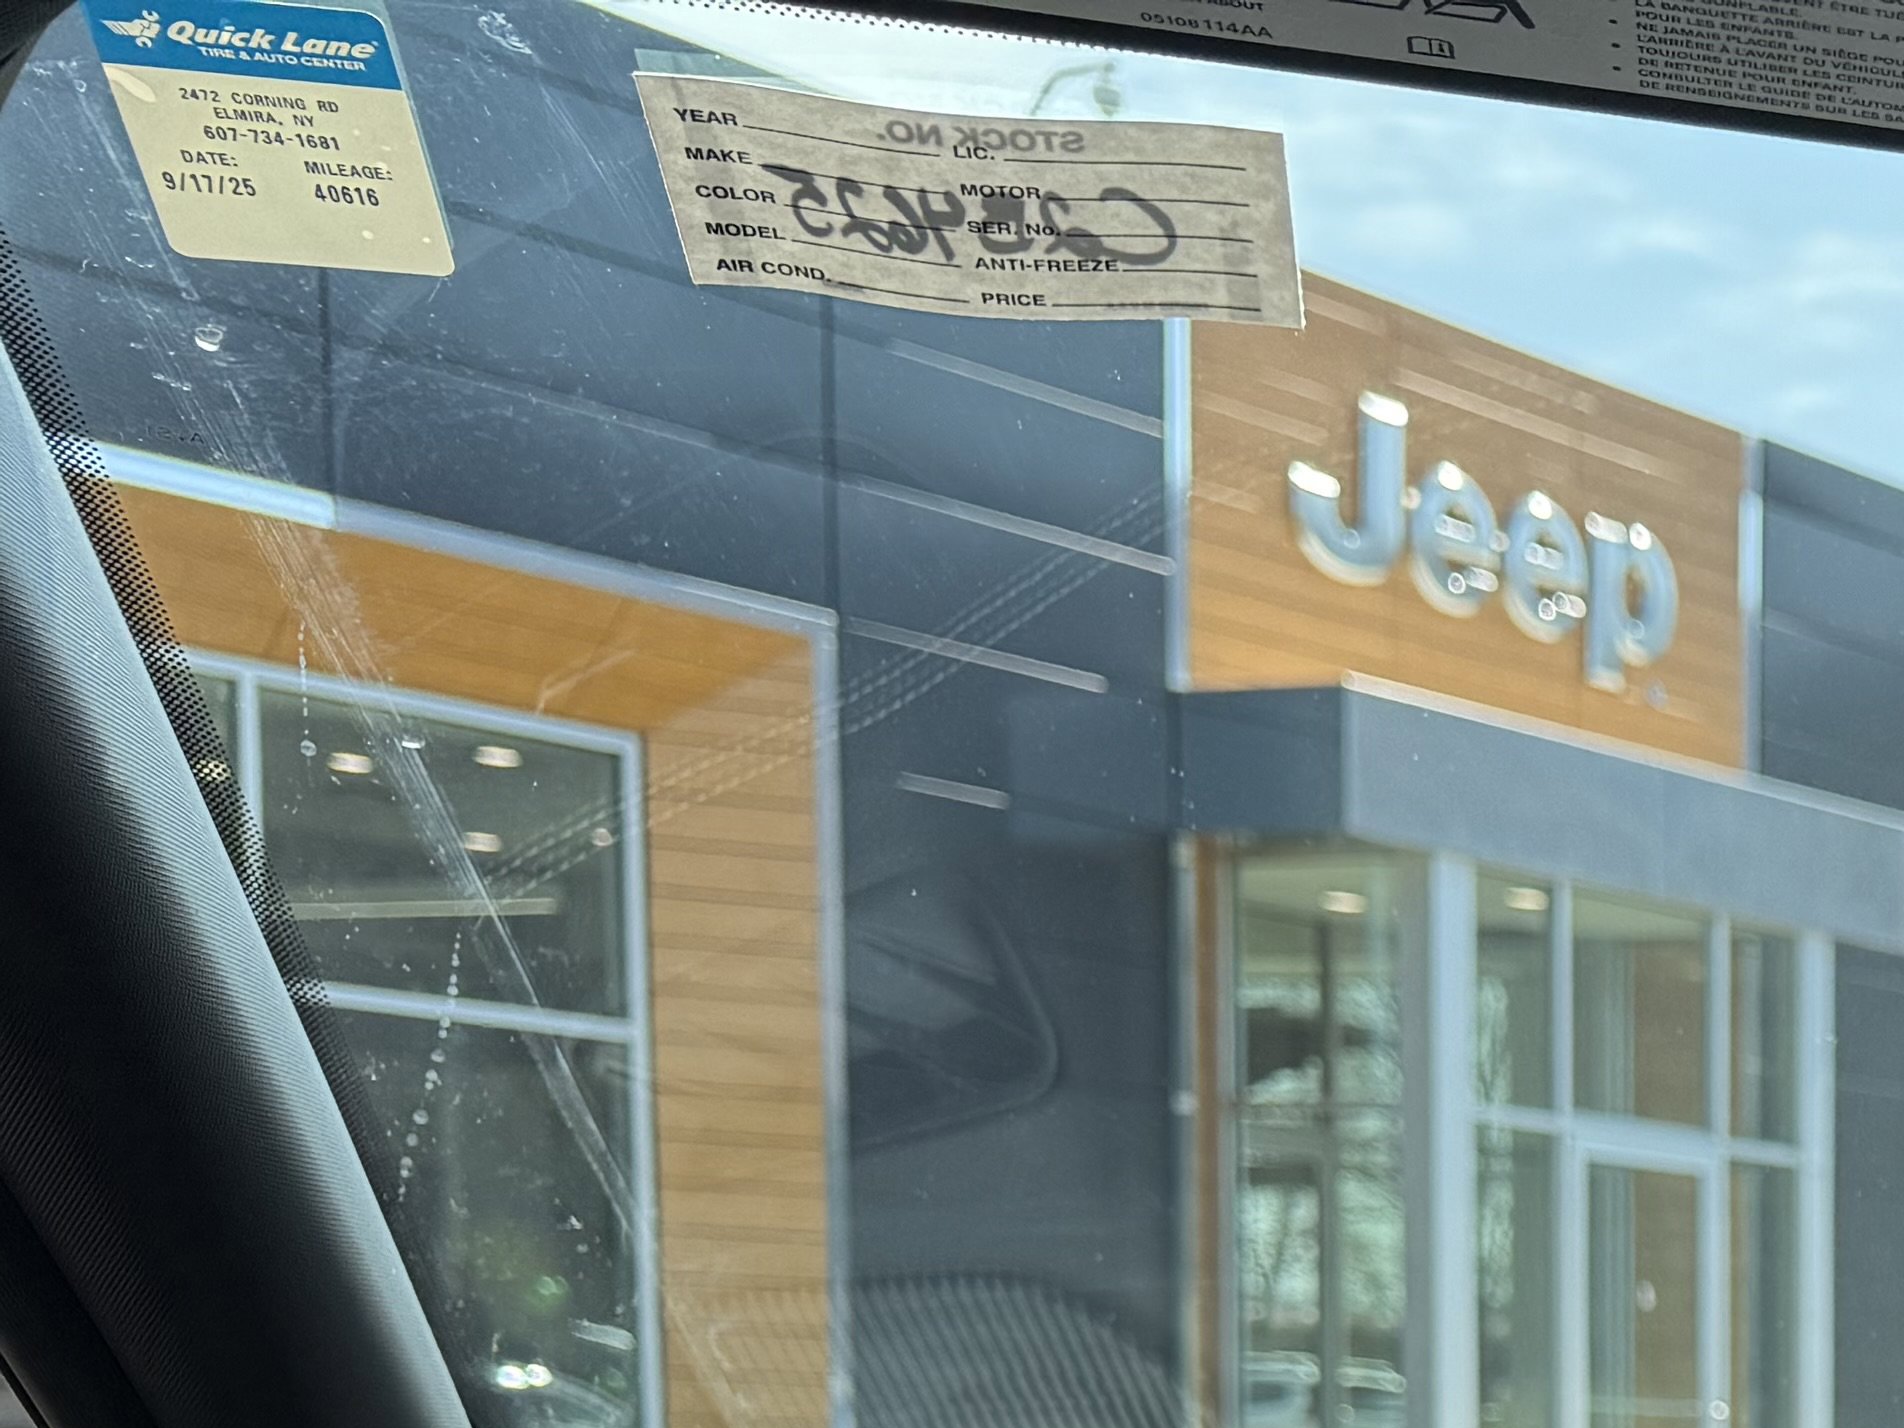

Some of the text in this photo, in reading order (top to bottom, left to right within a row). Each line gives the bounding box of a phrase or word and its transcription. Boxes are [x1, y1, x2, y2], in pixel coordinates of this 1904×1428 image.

[1636, 11, 1682, 24] POUR
[1661, 3, 1760, 23] BANQUETTE
[1871, 31, 1890, 43] LA
[167, 20, 377, 60] Quick Lane
[1637, 22, 1658, 33] NE
[1727, 34, 1789, 51] PLACER
[1793, 43, 1817, 55] UN
[200, 46, 366, 72] TIRE AUTO CENTER
[1638, 57, 1659, 67] DE
[1803, 57, 1825, 68] DU
[178, 87, 339, 114] 2472 CORNING RD
[1639, 80, 1661, 90] DE
[1740, 81, 1758, 92] LE
[1816, 93, 1836, 103] DE
[293, 113, 314, 128] NY
[673, 106, 996, 162] YEAR LIC.
[203, 125, 340, 152] 607-734-1681
[180, 149, 393, 182] DATE: MILEAGE:
[685, 147, 1041, 201] MAKE MOTOR
[161, 171, 380, 208] 9/17/25 40616
[695, 184, 1061, 238] COLOR SER. No.
[705, 222, 1119, 274] MODEL ANTI-FREEZE
[716, 258, 1046, 308] AIR COND. PRICE
[1288, 389, 1680, 695] Jeep
